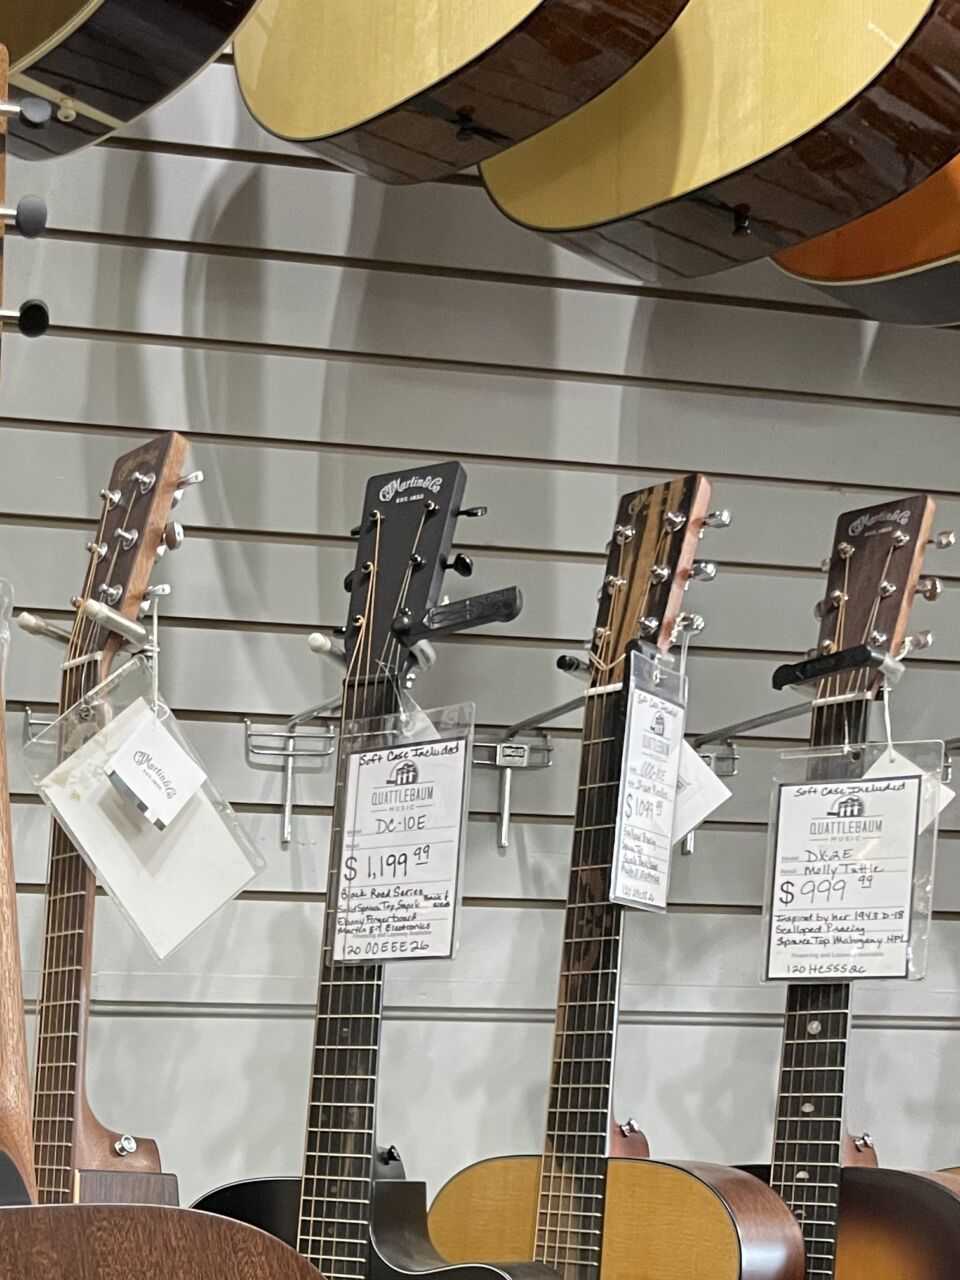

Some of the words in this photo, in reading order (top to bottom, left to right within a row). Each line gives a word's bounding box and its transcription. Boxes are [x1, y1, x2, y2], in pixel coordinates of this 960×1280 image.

[359, 754, 383, 767] Soft
[387, 751, 409, 761] Case
[411, 742, 459, 758] Included
[371, 786, 434, 806] QUATTLEBAUM
[794, 787, 817, 797] Soft
[847, 782, 906, 794] Included
[389, 804, 415, 812] MUSIC
[375, 814, 427, 834] DC-10E
[809, 820, 883, 835] QUATTLEBAUM
[804, 864, 839, 880] Molly
[839, 863, 884, 875] Tuttle
[816, 912, 829, 924] by
[854, 911, 878, 920] 1943
